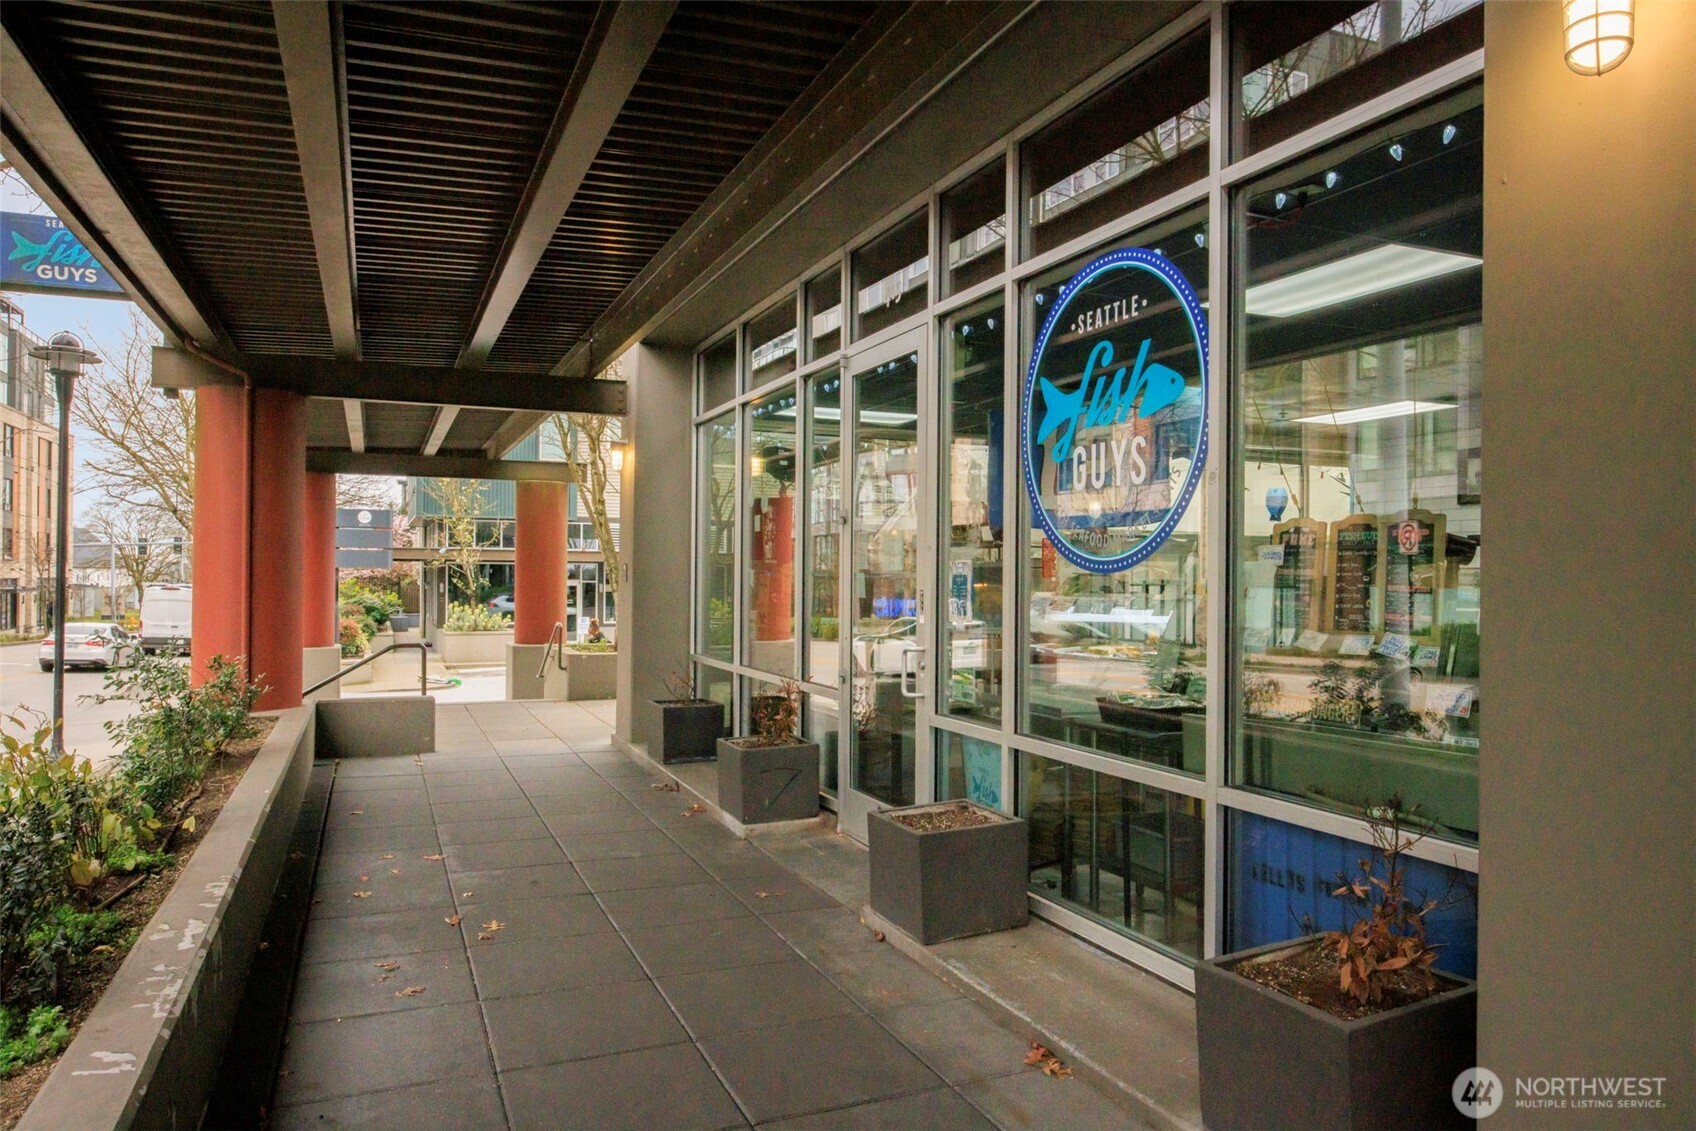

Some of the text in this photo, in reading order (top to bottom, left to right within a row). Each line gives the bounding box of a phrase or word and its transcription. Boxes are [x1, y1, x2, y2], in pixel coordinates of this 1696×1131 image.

[36, 264, 98, 283] GUYS
[1037, 338, 1185, 463] fish
[1073, 435, 1147, 491] GUYS
